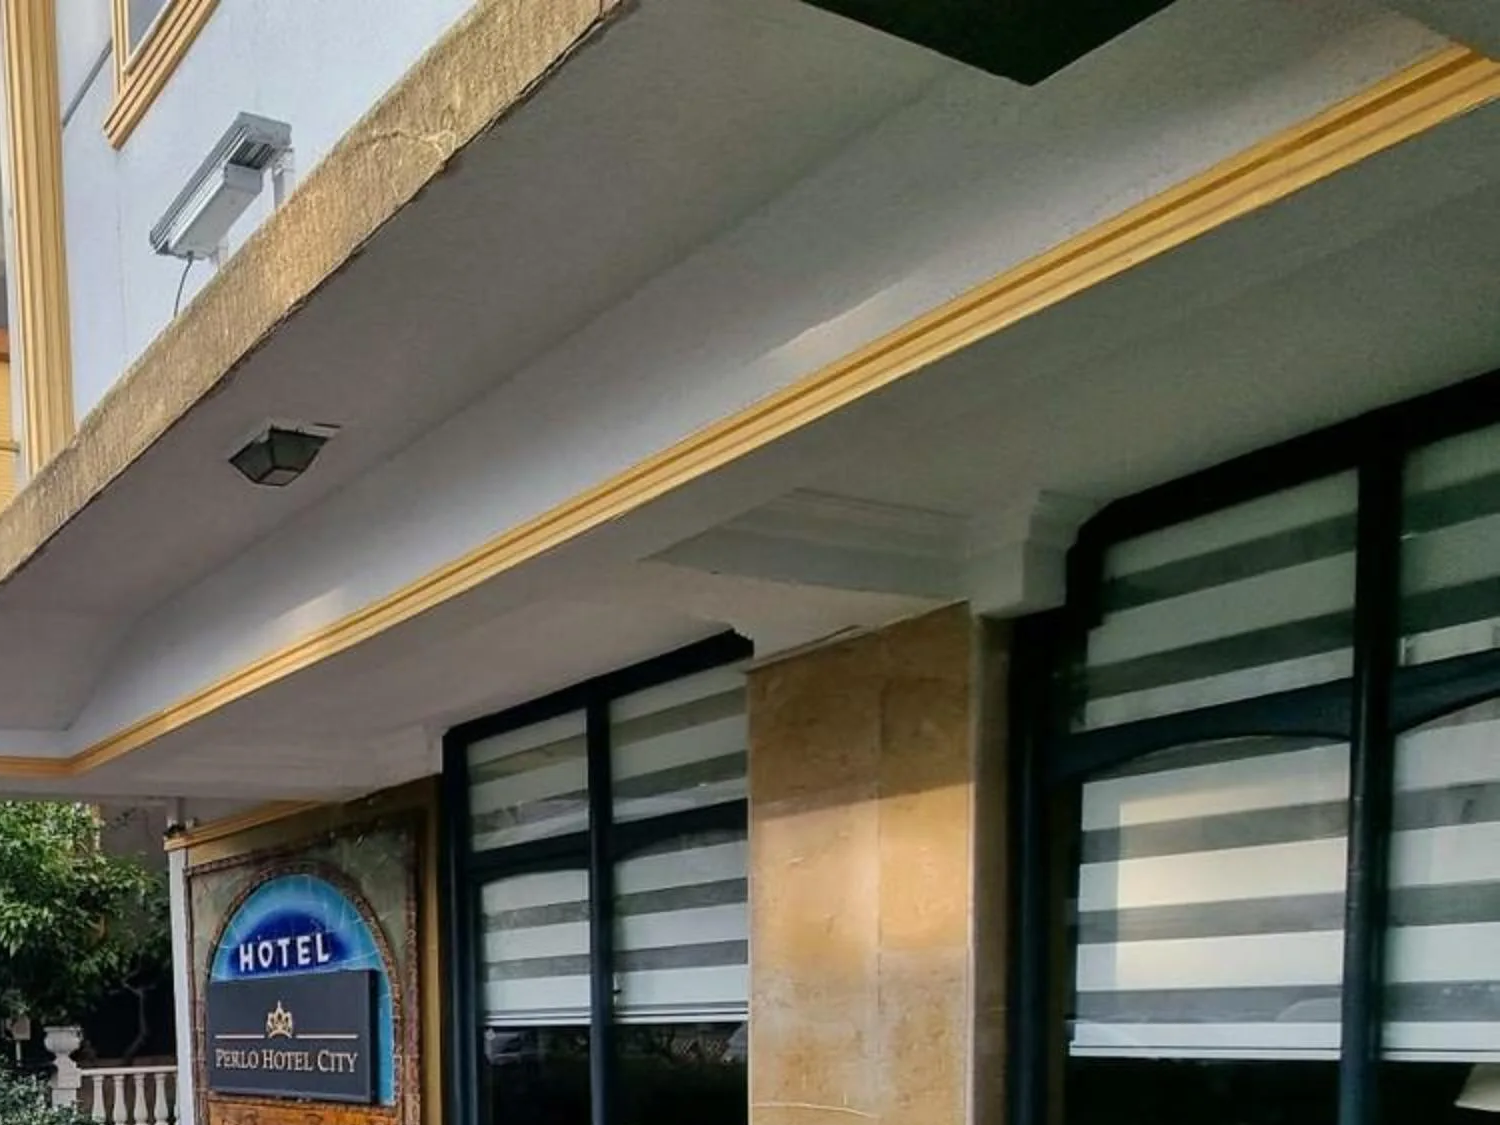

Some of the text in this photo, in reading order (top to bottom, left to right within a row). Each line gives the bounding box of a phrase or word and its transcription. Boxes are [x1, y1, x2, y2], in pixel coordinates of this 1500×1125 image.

[239, 932, 331, 972] HOTEL
[215, 1048, 359, 1073] PERLO HOTEL CITY
